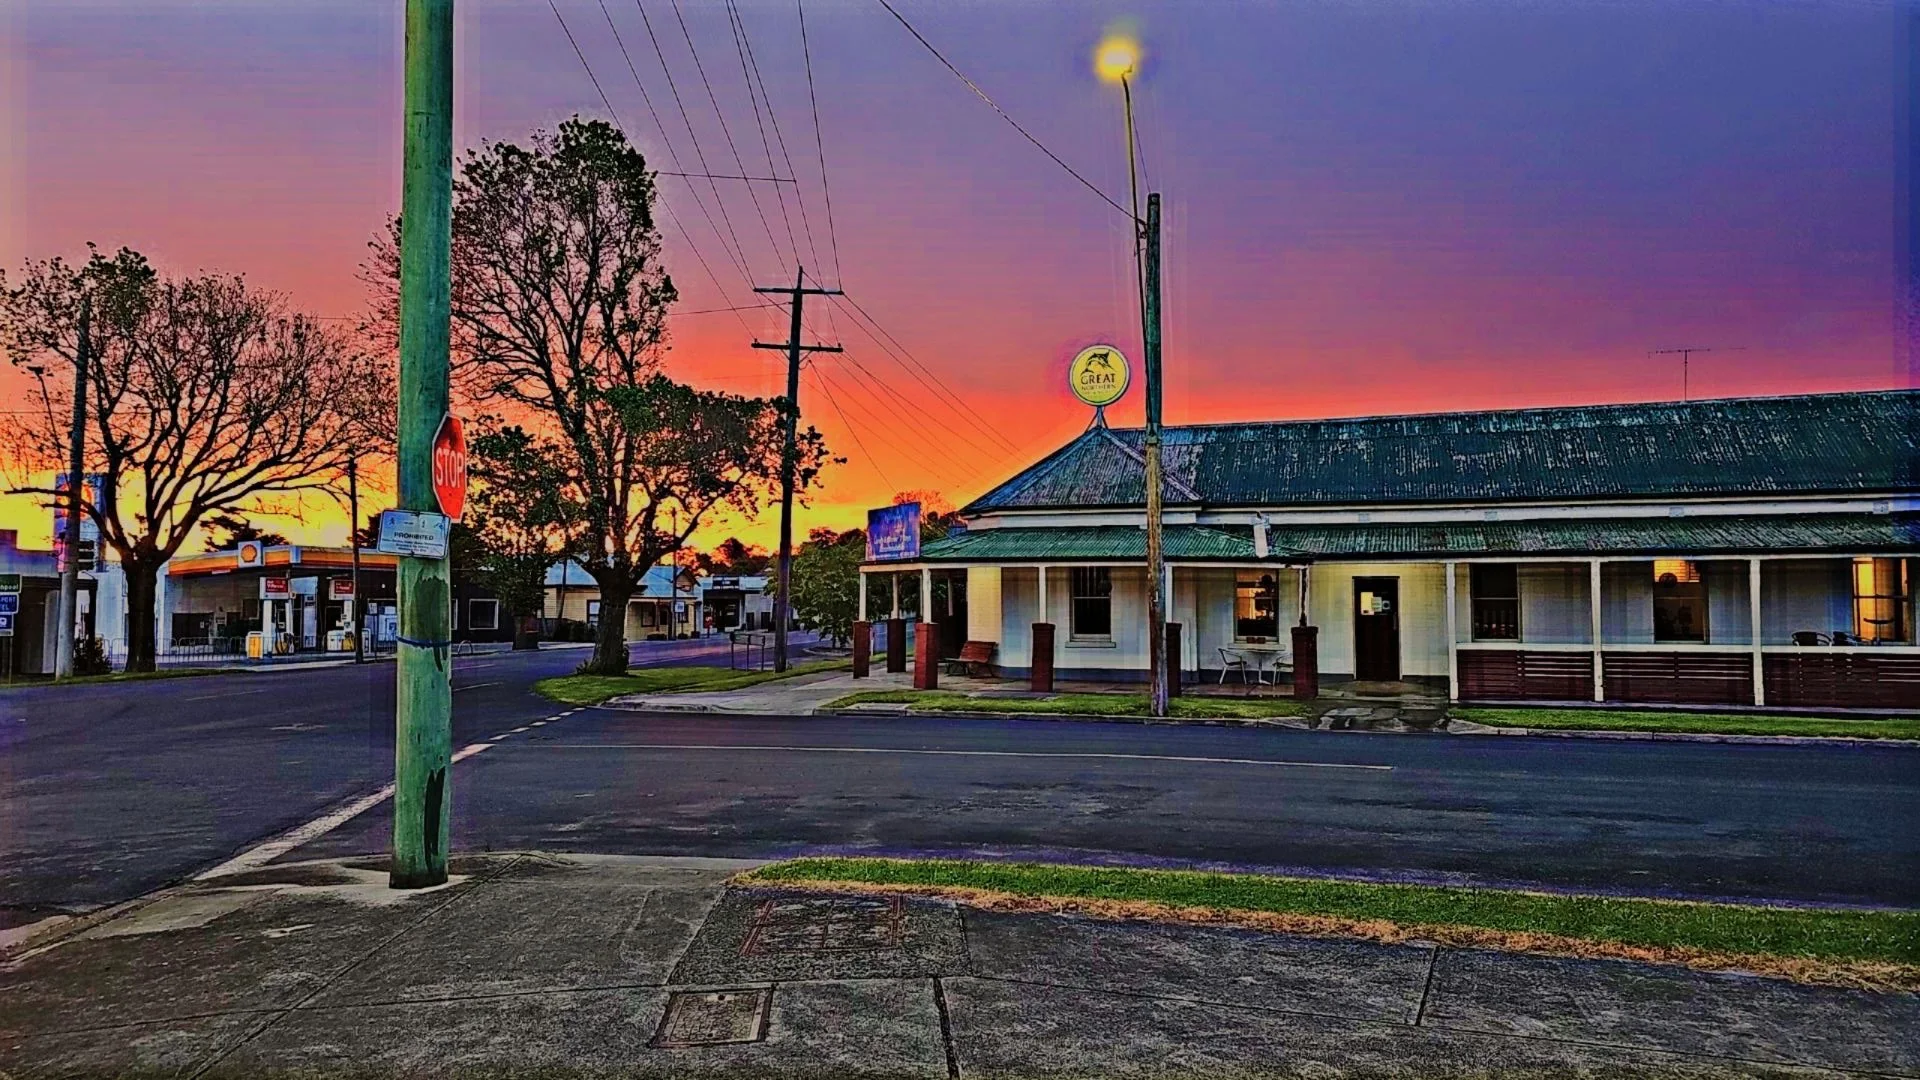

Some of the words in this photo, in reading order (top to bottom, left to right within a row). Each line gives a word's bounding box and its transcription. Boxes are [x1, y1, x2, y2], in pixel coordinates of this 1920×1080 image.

[1081, 373, 1115, 384] GREAT
[436, 447, 464, 488] STOP
[394, 532, 434, 541] PROHIBITED
